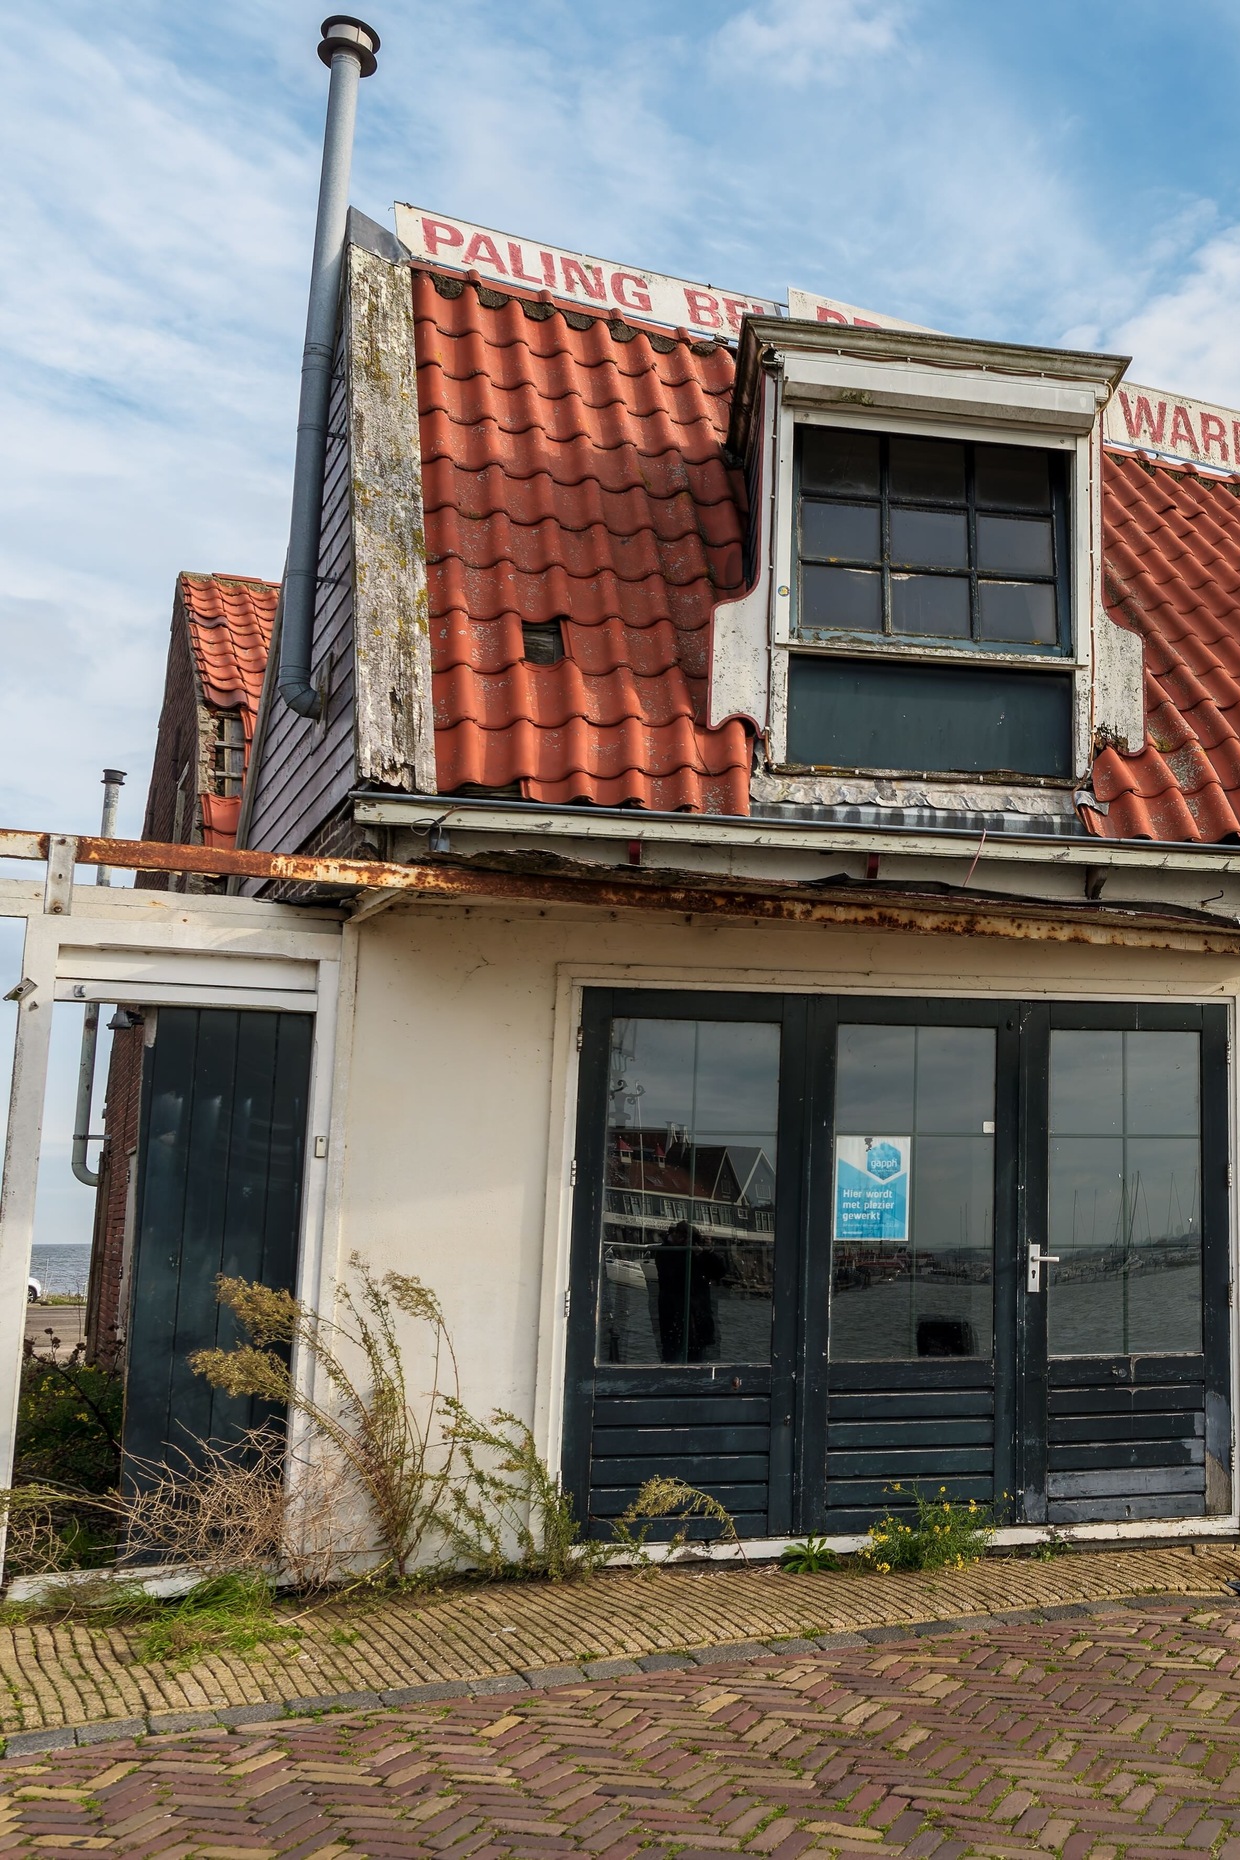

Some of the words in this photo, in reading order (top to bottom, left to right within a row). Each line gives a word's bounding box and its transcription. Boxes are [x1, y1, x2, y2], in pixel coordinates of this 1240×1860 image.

[421, 217, 653, 312] PALING
[683, 287, 764, 334] BE
[843, 1189, 862, 1198] Hier
[866, 1190, 893, 1198] wordt
[842, 1201, 861, 1209] met
[864, 1200, 895, 1211] plezier
[842, 1212, 881, 1221] gewerkt
